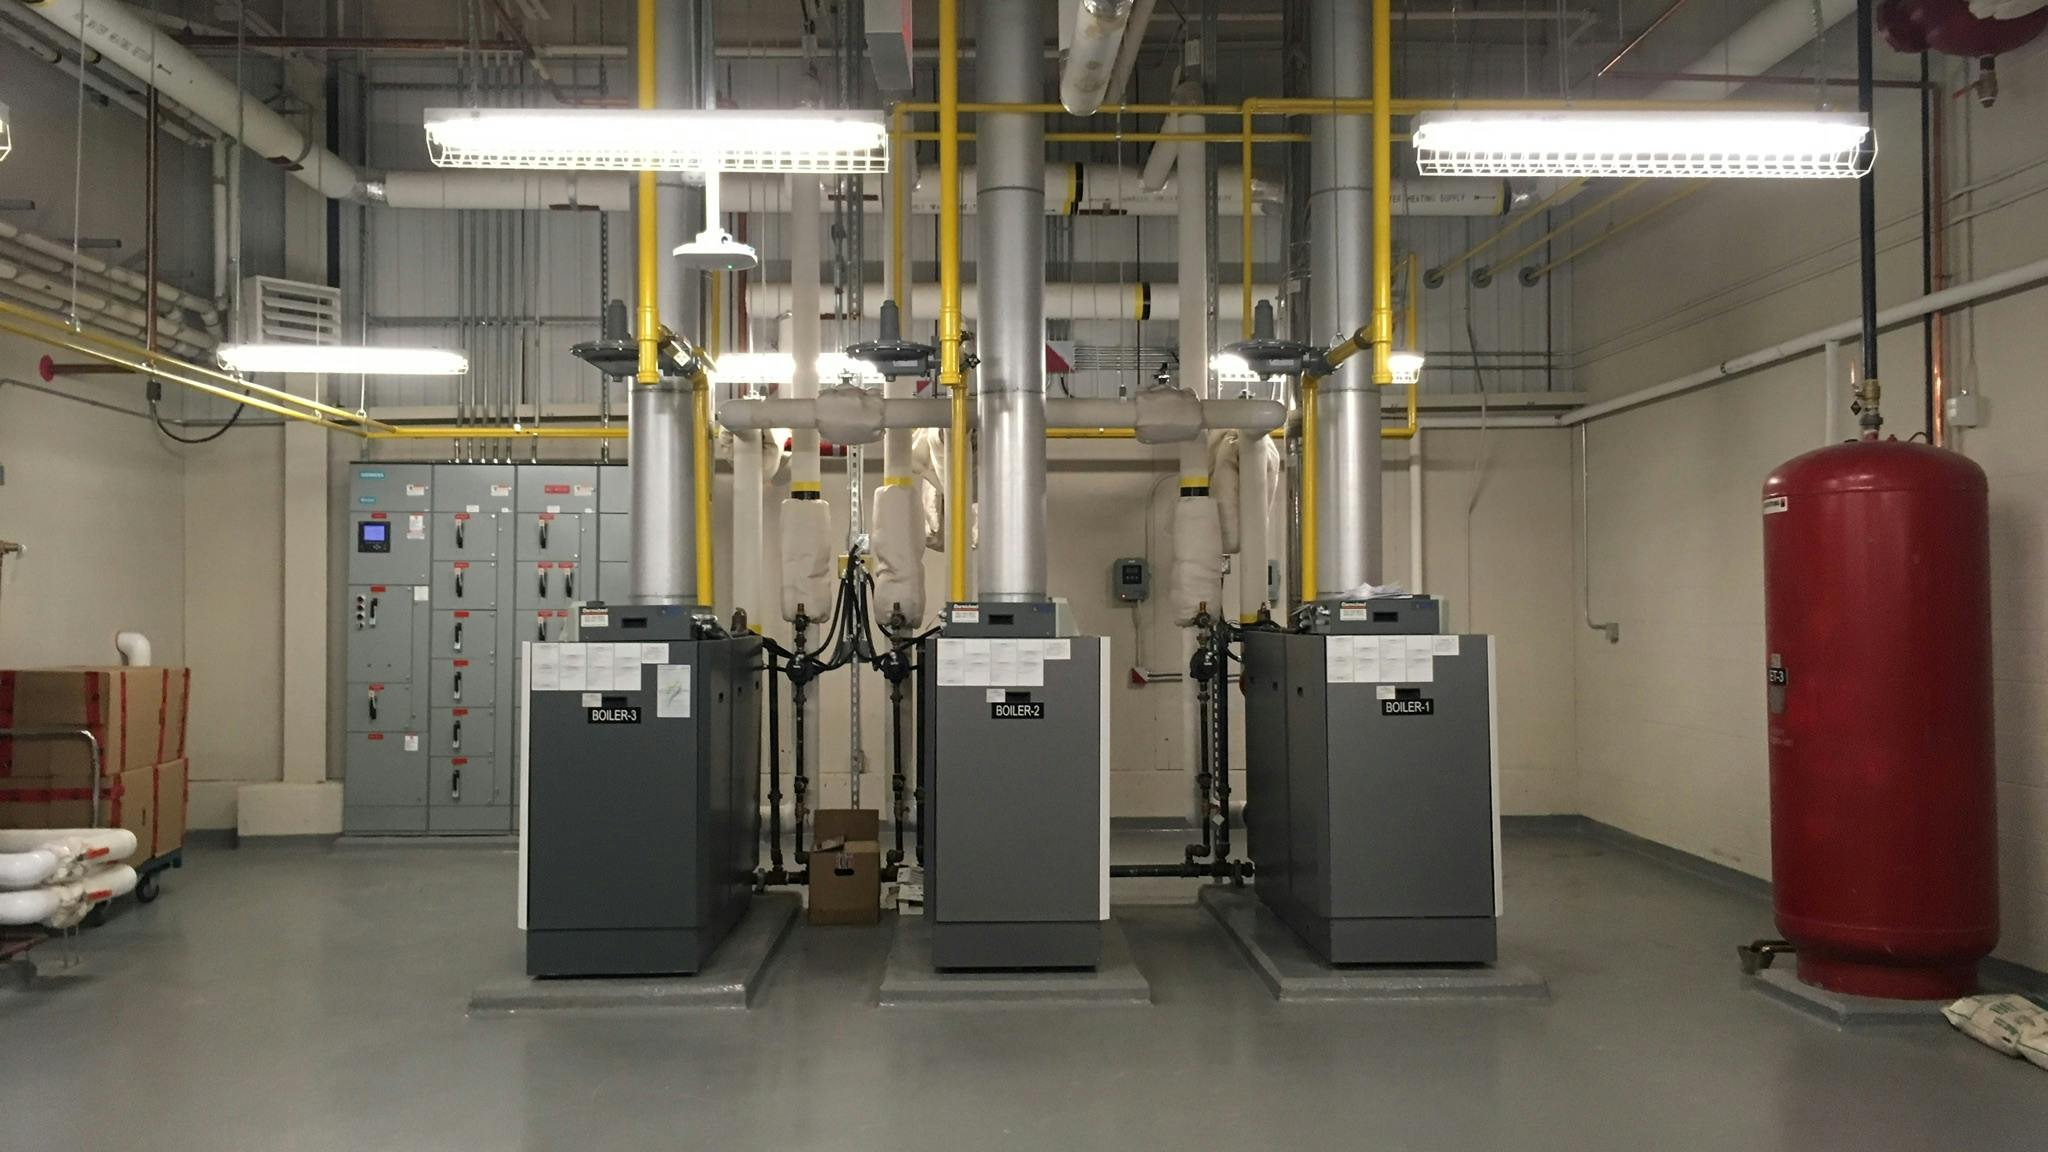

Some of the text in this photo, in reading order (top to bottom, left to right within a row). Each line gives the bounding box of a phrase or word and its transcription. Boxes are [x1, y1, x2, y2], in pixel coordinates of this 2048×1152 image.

[1440, 193, 1466, 203] SUPPLY
[1769, 670, 1785, 683] ET-3
[995, 704, 1041, 717] BOILER-2
[1385, 701, 1431, 714] BOILER-1
[591, 709, 638, 722] BOILER-3
